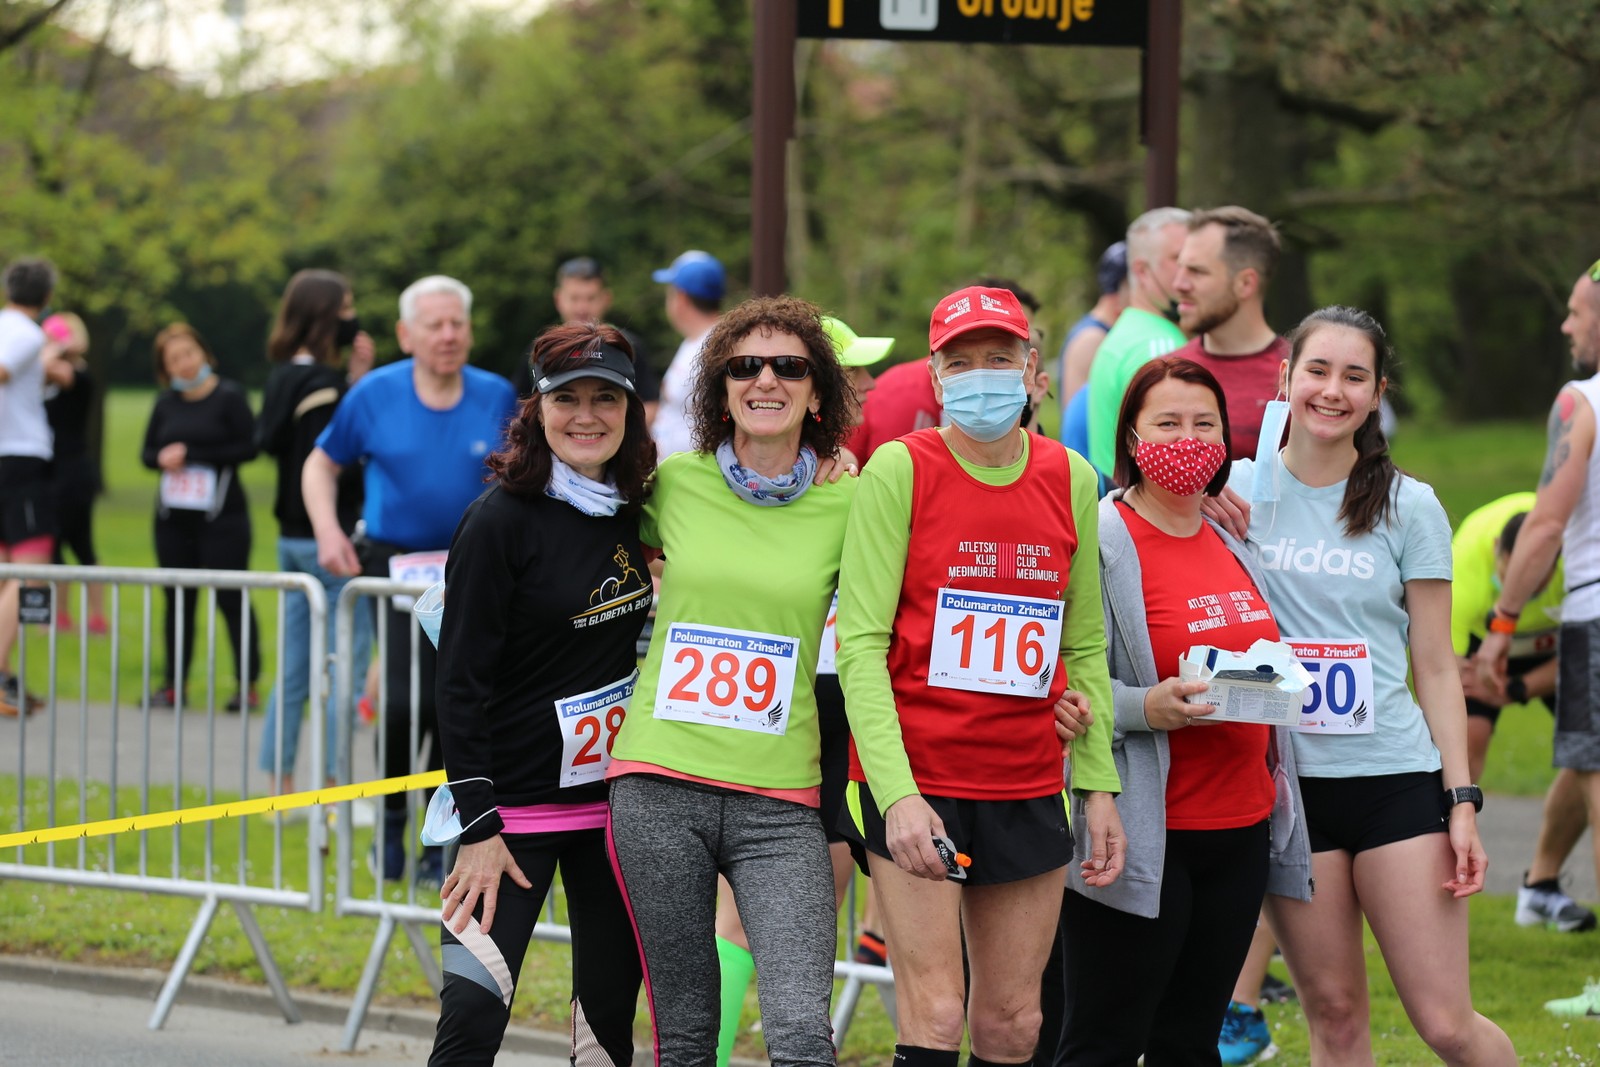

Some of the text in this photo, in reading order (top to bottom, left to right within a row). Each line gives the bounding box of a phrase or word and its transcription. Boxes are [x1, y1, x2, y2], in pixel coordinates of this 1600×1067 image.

[958, 541, 997, 553] ATLETSKI
[1016, 543, 1051, 557] ATHLETIC
[975, 554, 997, 566] KLUB
[1016, 556, 1037, 568] CLUB
[1260, 537, 1375, 579] didas
[1187, 594, 1220, 610] ATLETSKI
[1228, 590, 1254, 601] ATHLETIC
[588, 603, 633, 626] GLOBETKA
[946, 596, 1051, 618] Polumaraton Zrinski
[1205, 604, 1224, 617] KLUB
[1234, 601, 1251, 612] CLUB
[674, 631, 784, 655] Polumaraton Zrinski
[951, 614, 1046, 677] 116
[1323, 646, 1358, 657] Zrinski
[667, 647, 777, 713] 289
[1300, 662, 1356, 716] 50
[565, 691, 623, 716] Polumaraton
